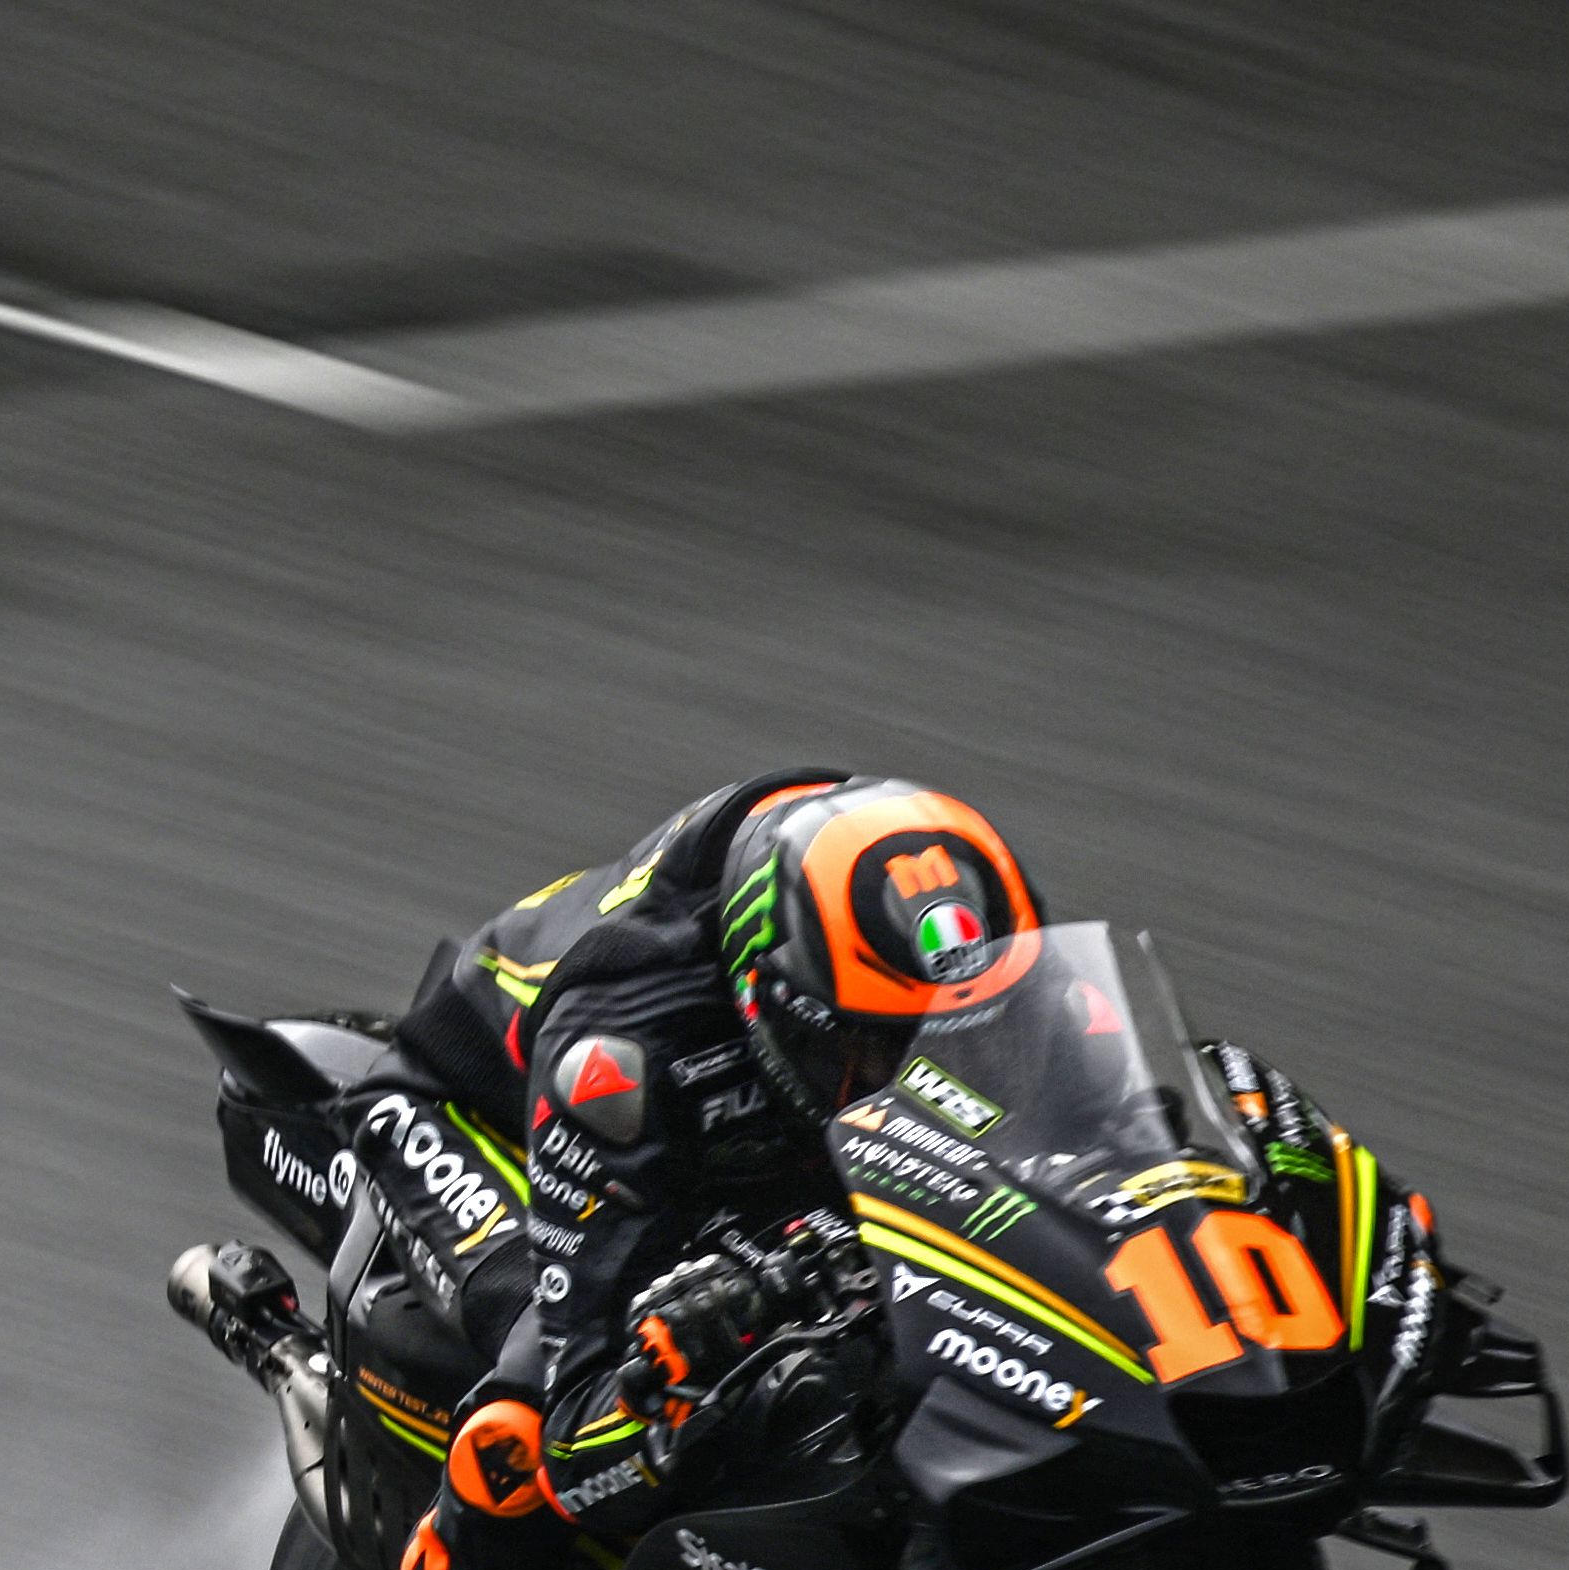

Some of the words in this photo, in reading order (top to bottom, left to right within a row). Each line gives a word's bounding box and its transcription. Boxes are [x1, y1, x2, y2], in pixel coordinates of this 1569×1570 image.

[262, 1126, 328, 1206] flyme
[367, 1093, 519, 1255] mooney
[1104, 1210, 1347, 1385] 10
[927, 1327, 1105, 1428] mooney
